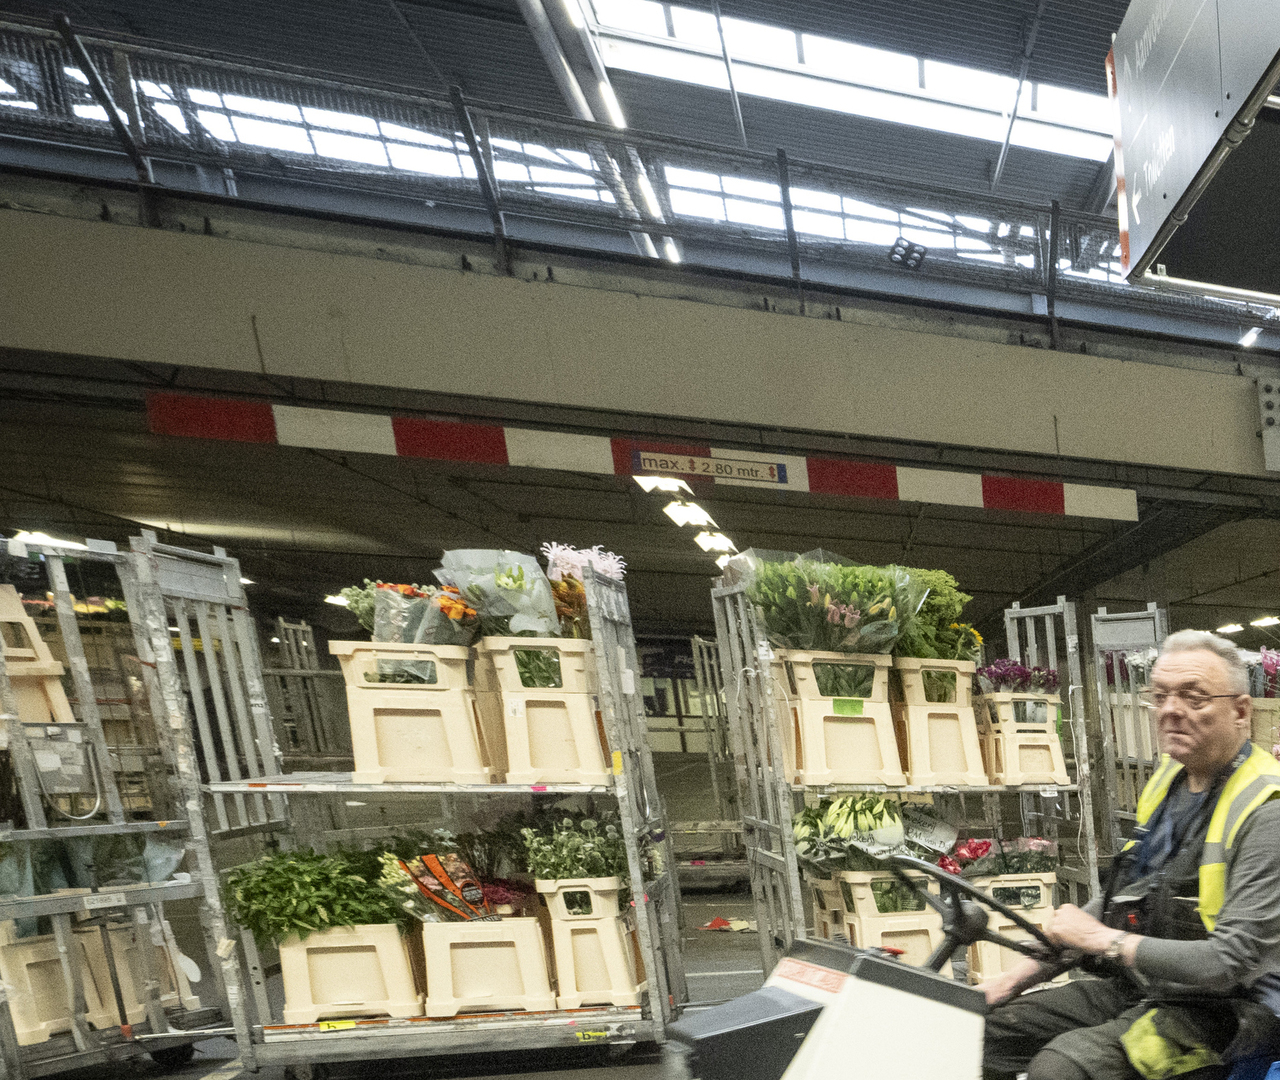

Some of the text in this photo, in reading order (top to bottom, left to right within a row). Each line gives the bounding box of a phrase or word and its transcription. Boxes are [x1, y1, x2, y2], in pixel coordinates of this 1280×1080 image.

[641, 456, 764, 479] max. 2.80 mtr.
